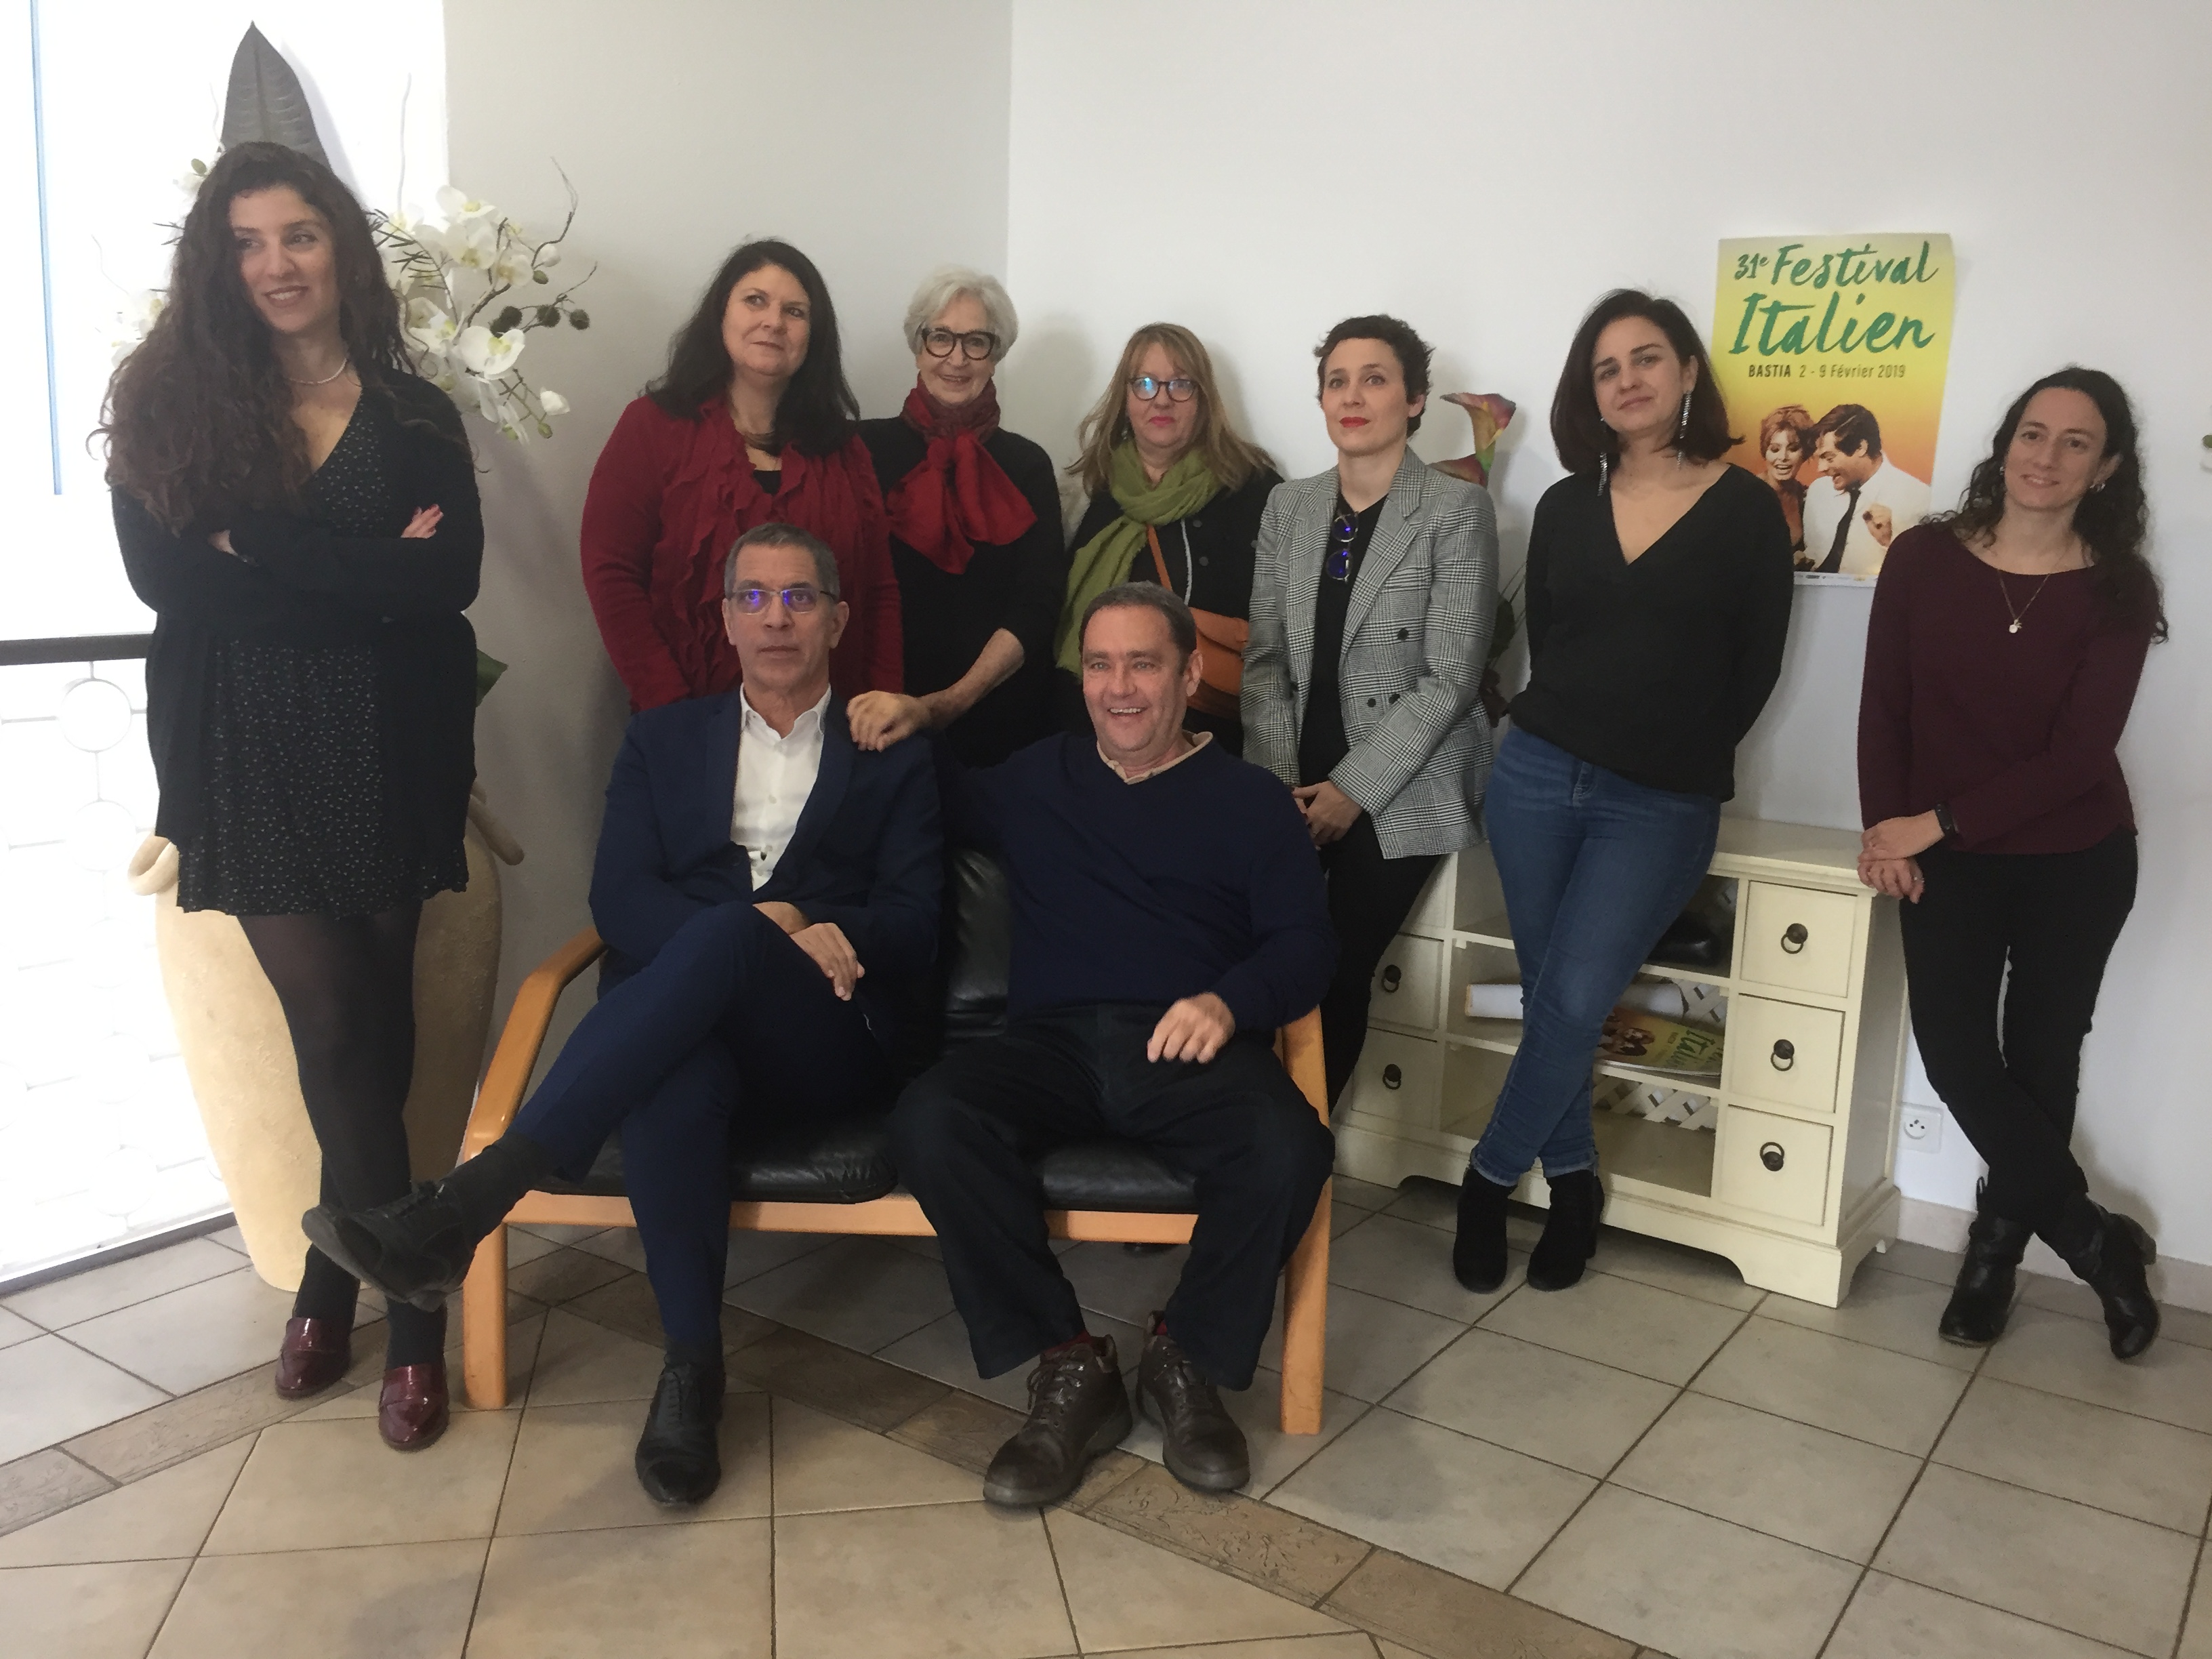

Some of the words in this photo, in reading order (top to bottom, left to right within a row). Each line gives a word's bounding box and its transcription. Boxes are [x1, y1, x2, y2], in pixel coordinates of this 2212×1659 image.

[1770, 241, 1940, 289] Festival
[1729, 291, 1936, 356] Italien
[1748, 364, 1791, 378] BASTIA
[1799, 364, 1807, 378] 2
[1819, 364, 1826, 378] 9
[1830, 364, 1875, 379] Février
[1877, 364, 1906, 378] 2019
